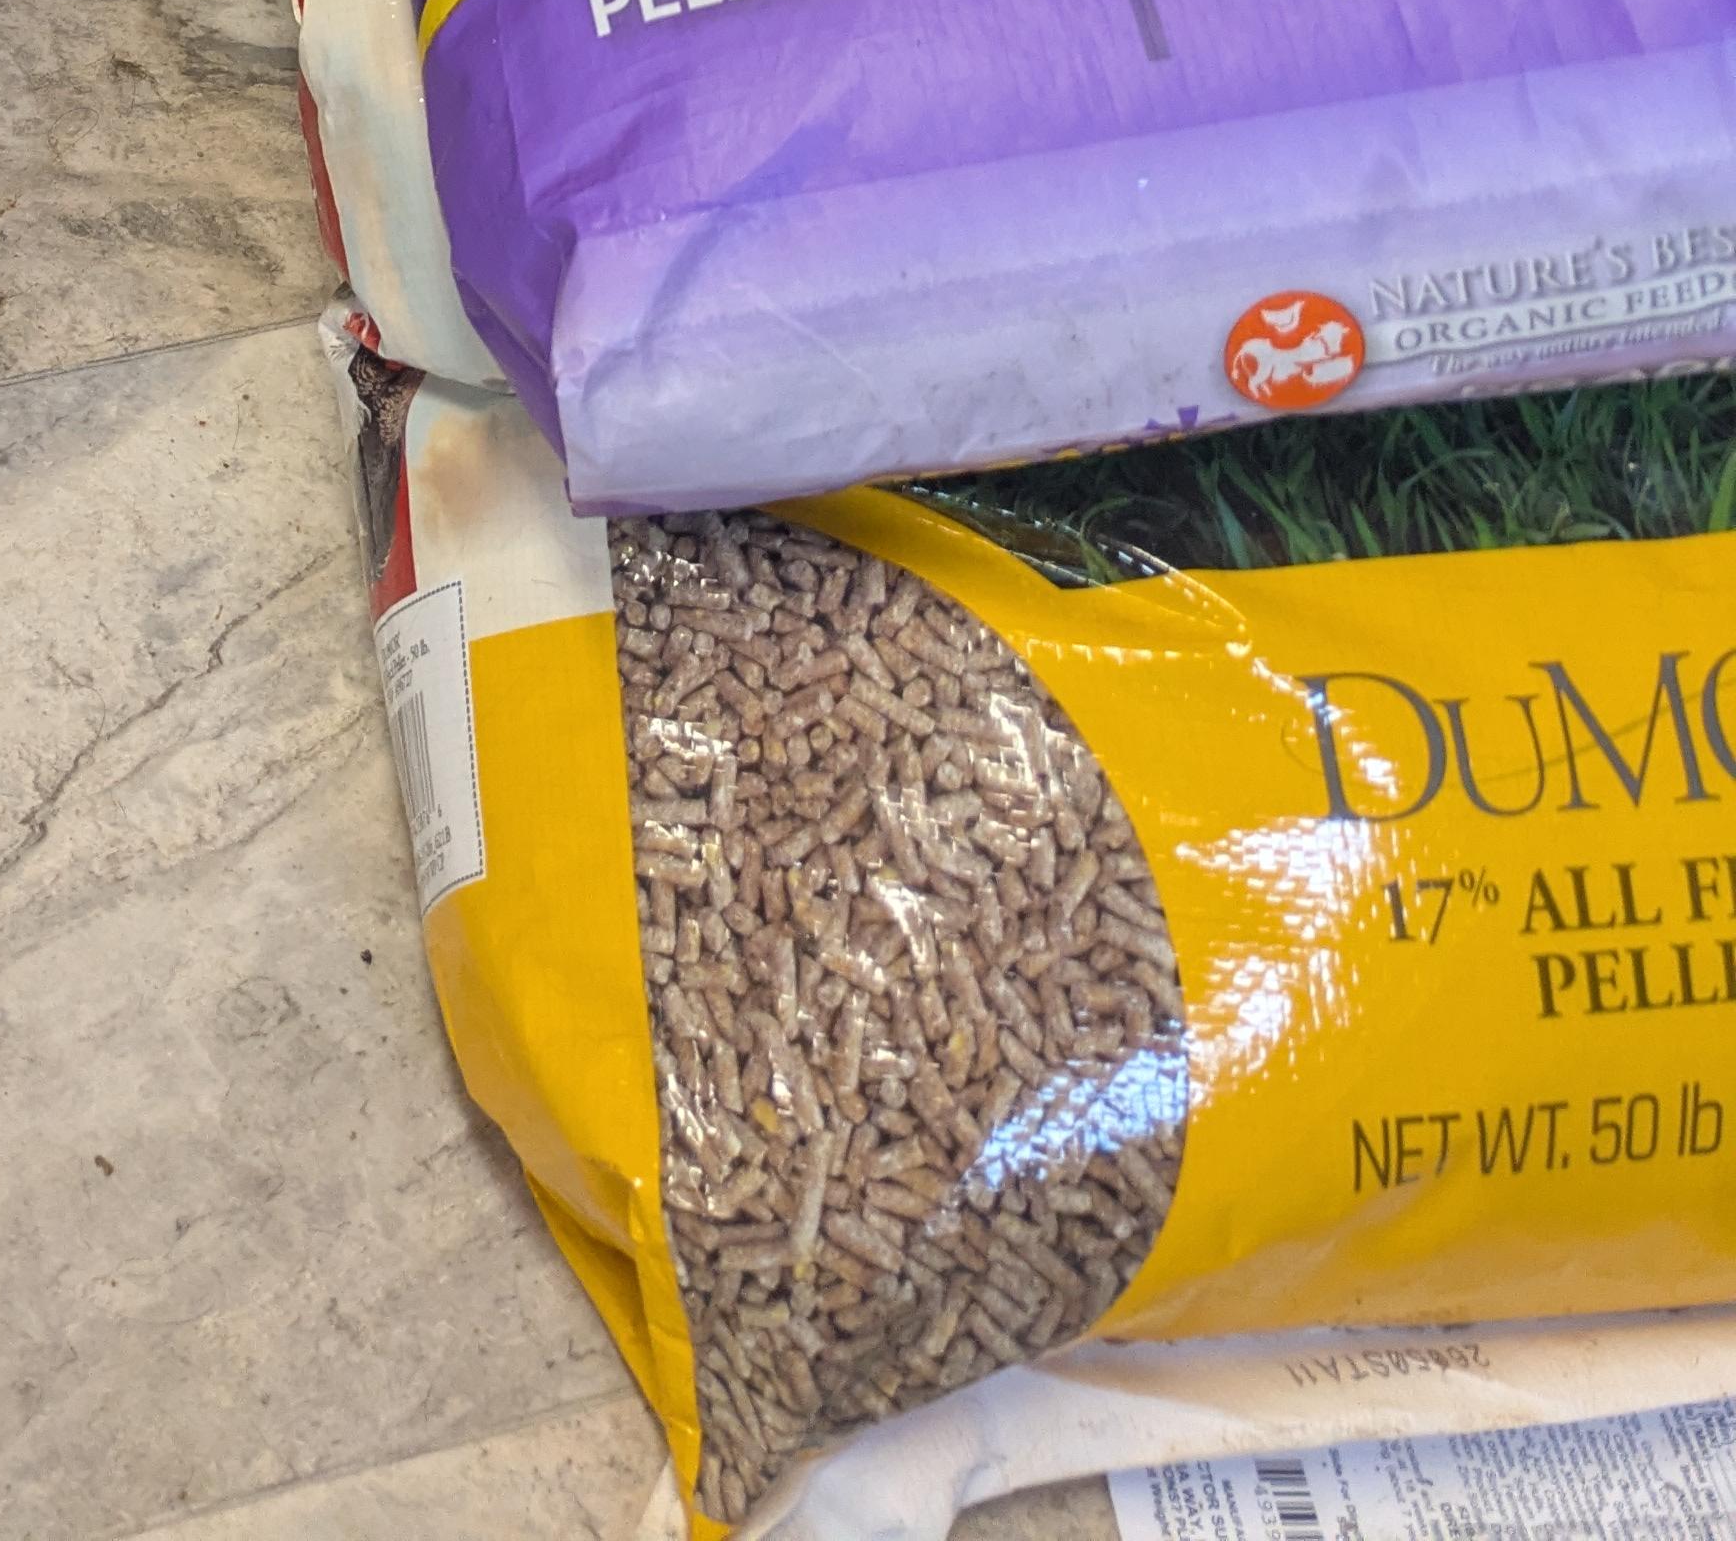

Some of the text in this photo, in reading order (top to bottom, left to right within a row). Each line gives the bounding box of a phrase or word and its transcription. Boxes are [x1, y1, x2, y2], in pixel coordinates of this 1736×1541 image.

[1368, 234, 1636, 319] NATURE'S
[1394, 296, 1608, 351] ORGANIC
[1382, 865, 1500, 946] 17%
[1520, 863, 1663, 935] ALL
[1352, 1081, 1723, 1193] NET WT. 50 lb
